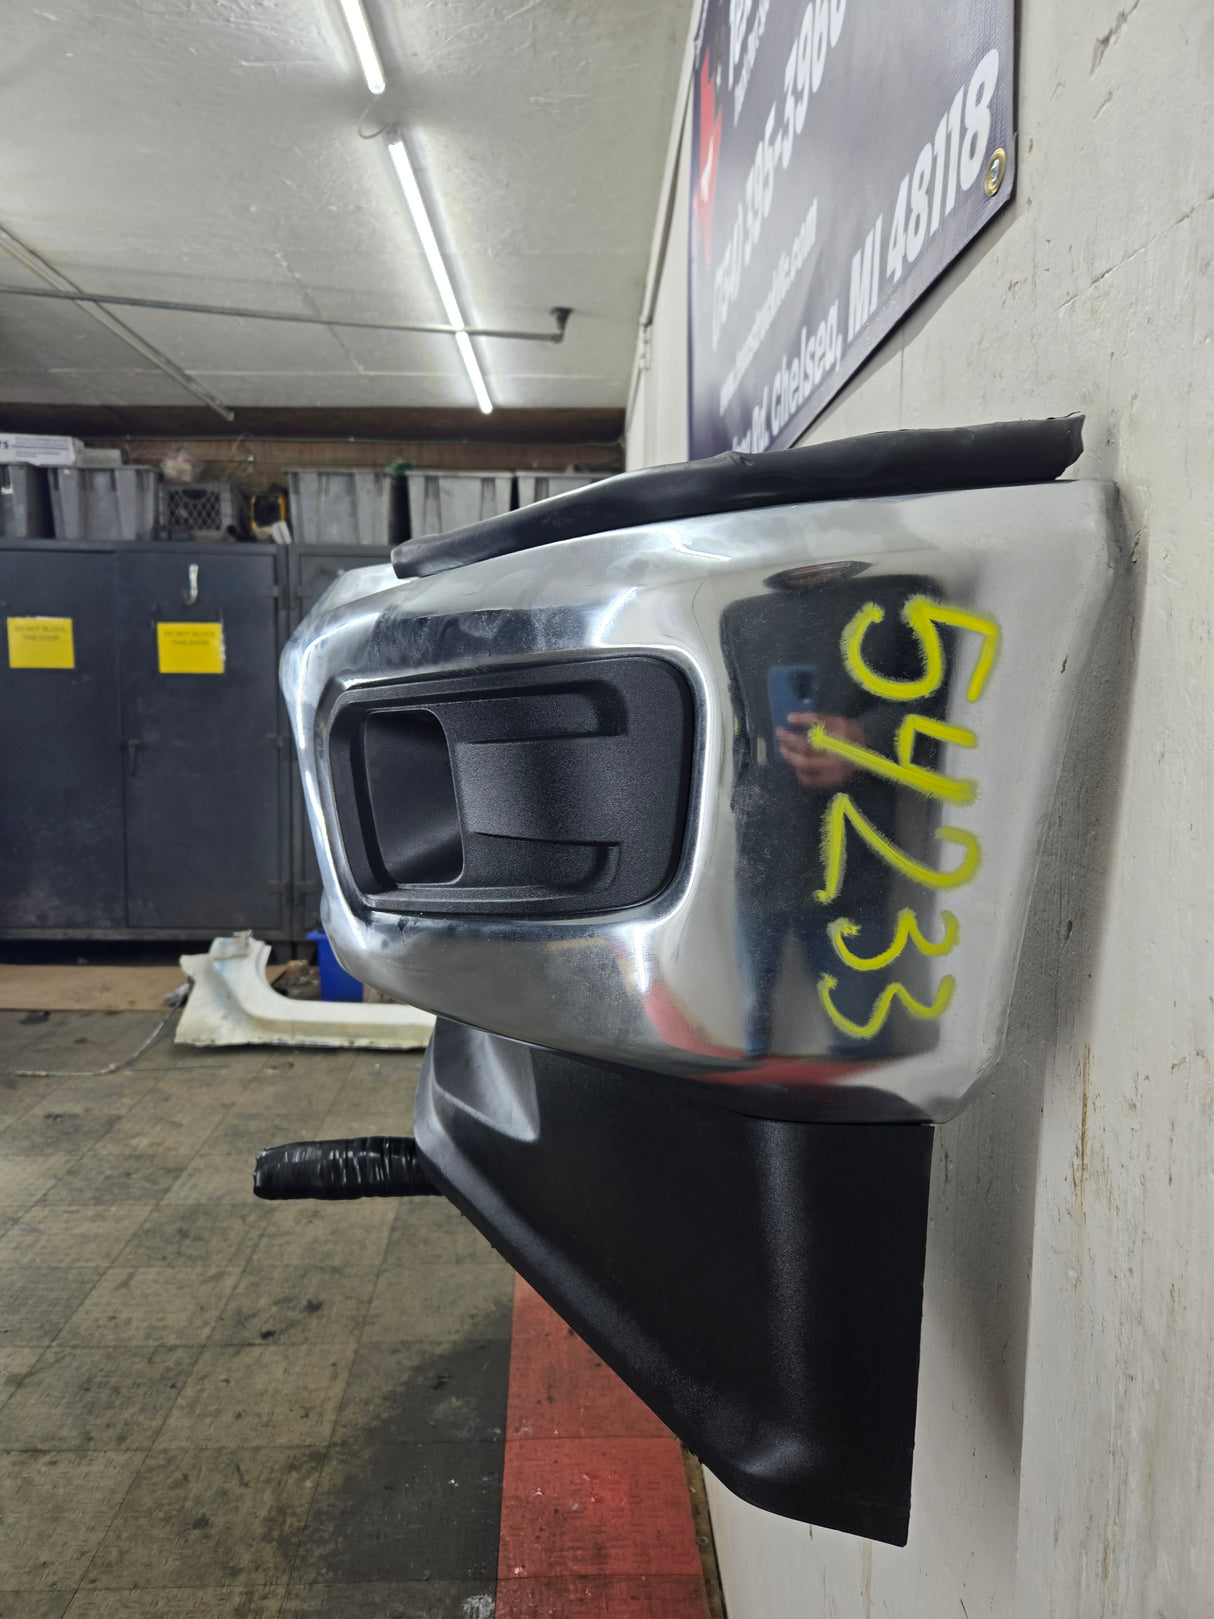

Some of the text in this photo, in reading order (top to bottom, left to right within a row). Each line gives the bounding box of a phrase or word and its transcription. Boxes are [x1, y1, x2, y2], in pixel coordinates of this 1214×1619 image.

[771, 299, 843, 437] Chelsea,
[848, 213, 883, 343] MI
[886, 48, 999, 284] 48118
[808, 594, 1001, 1040] 54233
